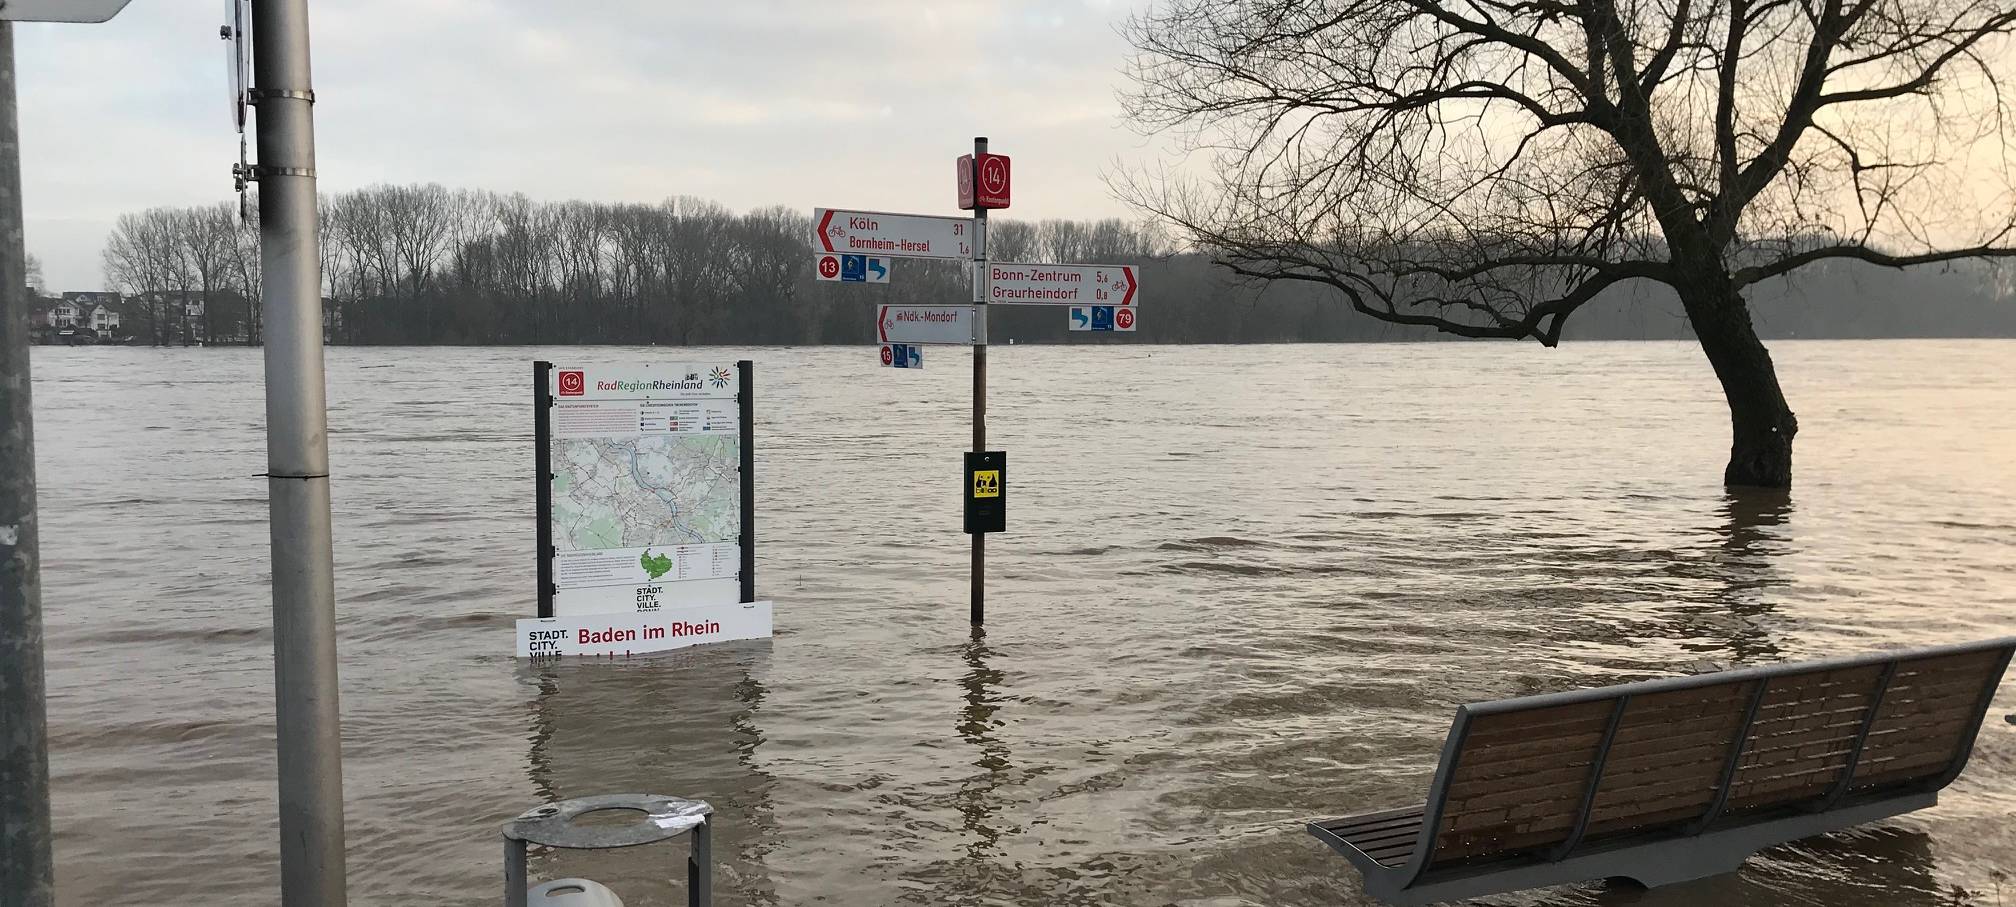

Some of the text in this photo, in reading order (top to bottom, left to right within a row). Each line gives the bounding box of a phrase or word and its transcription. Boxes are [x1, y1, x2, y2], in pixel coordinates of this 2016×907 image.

[988, 167, 1000, 185] 14
[849, 217, 963, 236] Köln 31
[849, 236, 930, 253] Bornheim-Hersel
[821, 262, 836, 273] 13
[992, 268, 1081, 283] Bonn-Zentrum
[992, 286, 1078, 300] Graurheindorf
[903, 310, 957, 323] Ndk.-Mondorf
[1119, 313, 1132, 324] 79
[882, 350, 891, 362] 15
[565, 377, 578, 386] 14
[597, 379, 704, 393] RadRegionRheinland
[636, 586, 664, 595] STADT.
[636, 594, 656, 602] CITY.
[636, 601, 662, 609] VILLE.
[529, 629, 569, 641] STADT.
[578, 619, 721, 645] Baden im Rhein
[529, 640, 558, 651] CITY.
